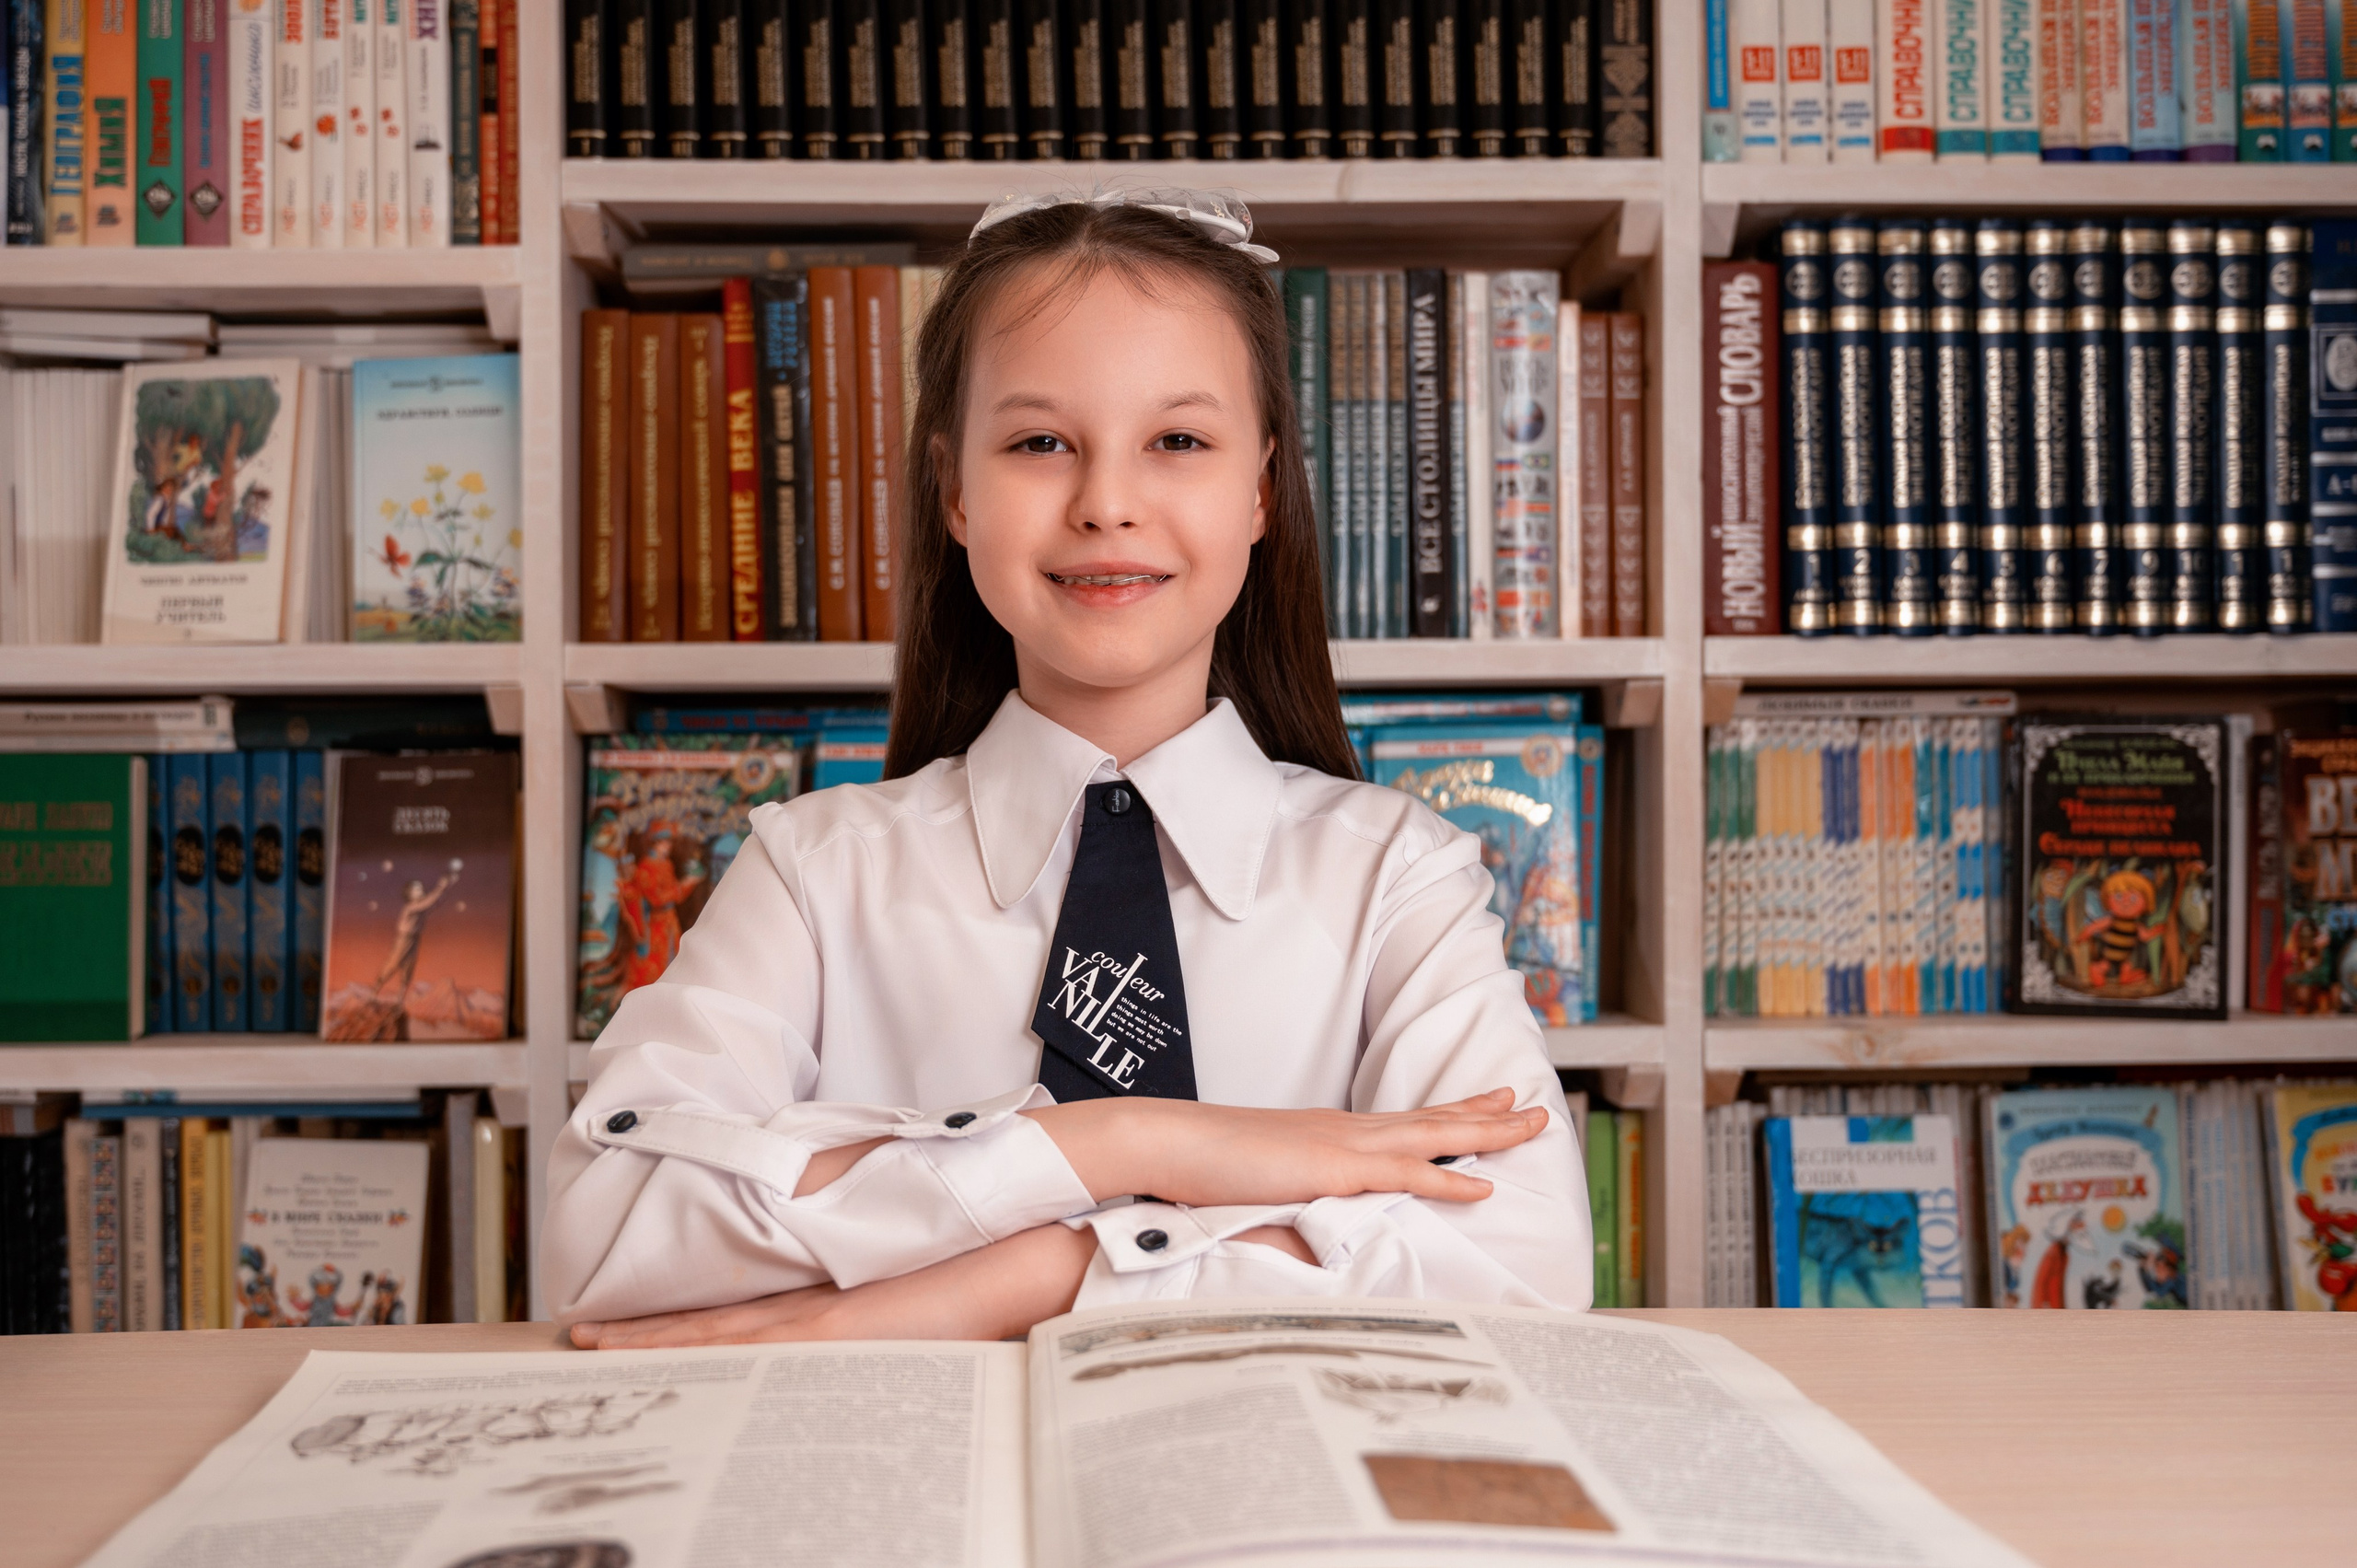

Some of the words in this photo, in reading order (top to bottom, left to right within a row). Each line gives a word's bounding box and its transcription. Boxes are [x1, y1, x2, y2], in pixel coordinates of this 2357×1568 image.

[241, 118, 264, 236] СПРАВОЧНИК
[1412, 293, 1437, 373] МИРА
[1719, 273, 1763, 405] СЛОВАРЬ
[728, 389, 754, 471] ВЕКА
[1415, 374, 1442, 518] СТОЛИЦЫ
[731, 489, 759, 633] СРЕДНИЕ
[1419, 519, 1444, 575] ВСЕ
[1853, 549, 1871, 575] 2
[1950, 549, 1969, 575] 4
[2093, 549, 2109, 575] 7
[2141, 550, 2159, 575] 9
[1713, 521, 1765, 618] НОВЫЙ
[2046, 552, 2064, 576] 6
[1111, 789, 1120, 813] Fashion
[1110, 1012, 1127, 1024] doing
[1155, 1038, 1167, 1048] down
[1116, 1004, 1133, 1017] things
[1134, 1016, 1147, 1026] most
[1120, 996, 1139, 1010] things
[1148, 1013, 1160, 1023] life
[1161, 1021, 1171, 1029] are
[1172, 1028, 1182, 1036] the
[1106, 1018, 1117, 1028] but
[1125, 1031, 1135, 1040] are
[1136, 1038, 1146, 1046] not
[1793, 1146, 1936, 1165] ЕСПРИЗОРНАЯ
[1794, 1168, 1857, 1185] ОШКА
